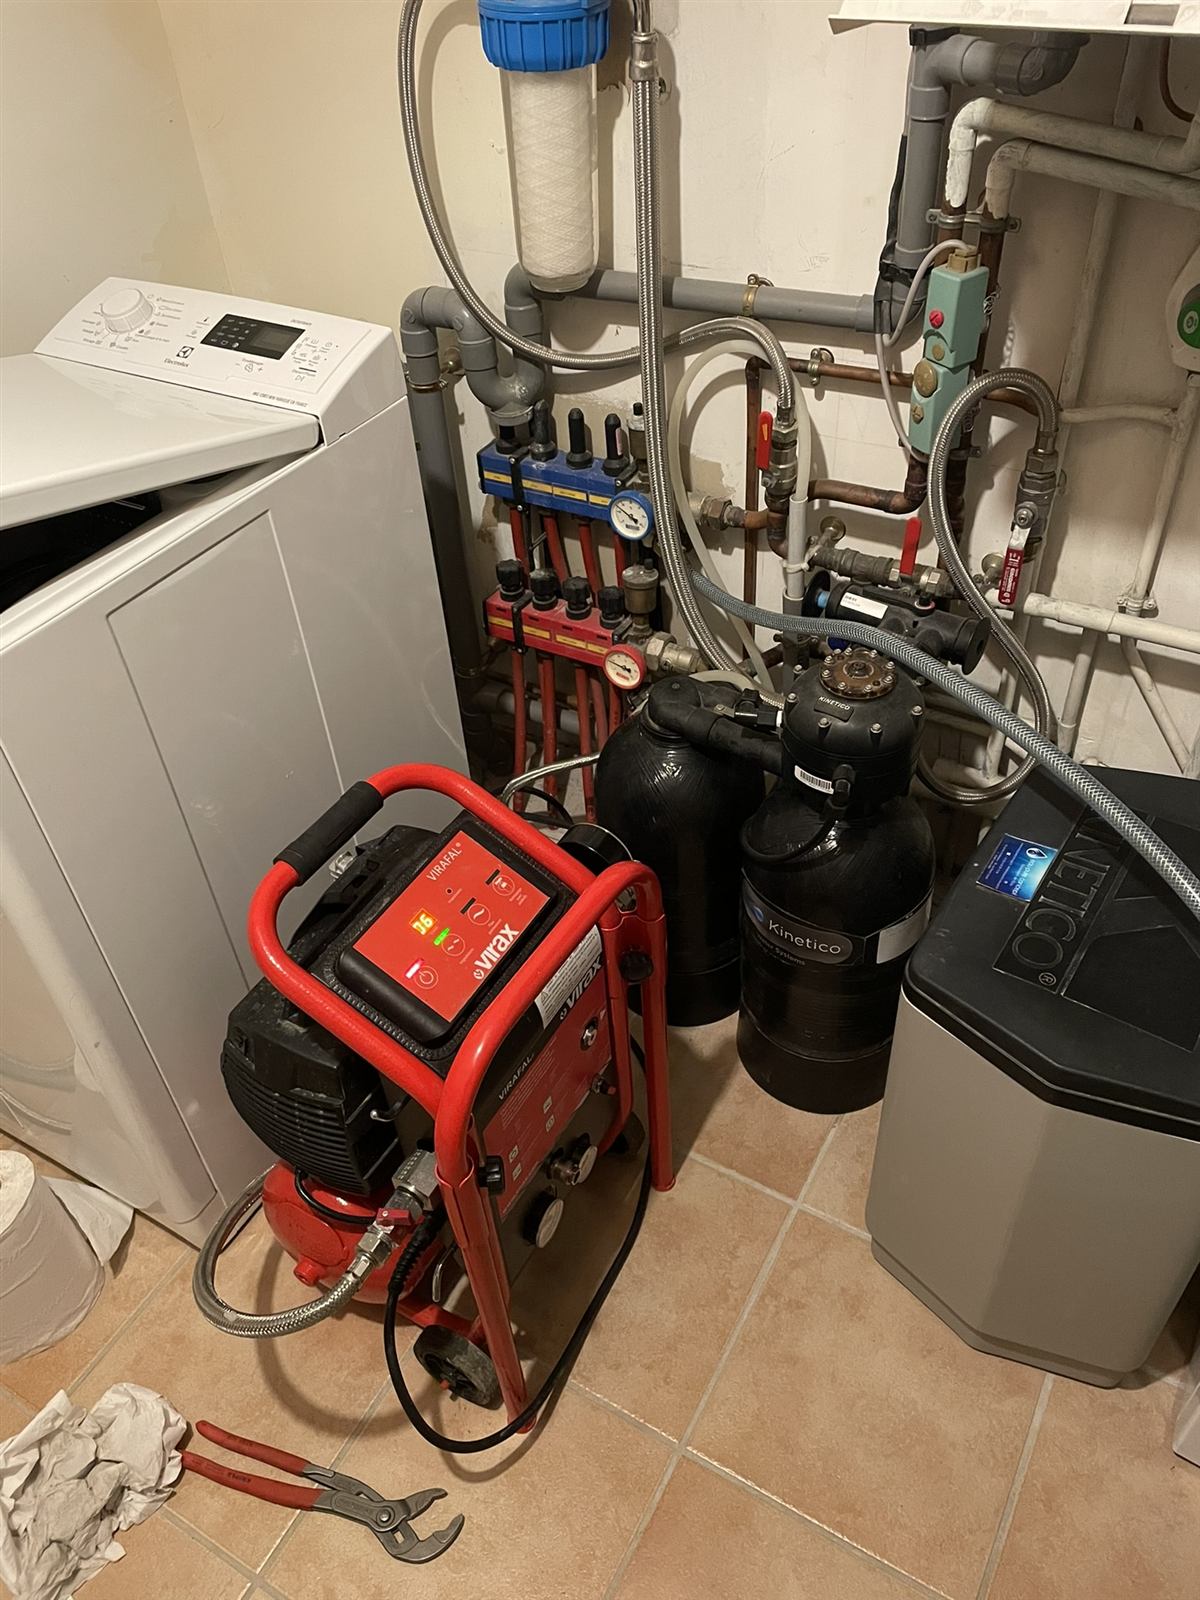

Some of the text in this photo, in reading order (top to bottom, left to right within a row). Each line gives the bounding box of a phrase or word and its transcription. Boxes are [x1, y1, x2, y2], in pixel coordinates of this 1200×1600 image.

[818, 696, 851, 711] KINETICO
[474, 923, 519, 971] virax
[768, 919, 841, 955] Kinetico
[566, 956, 602, 1008] virax
